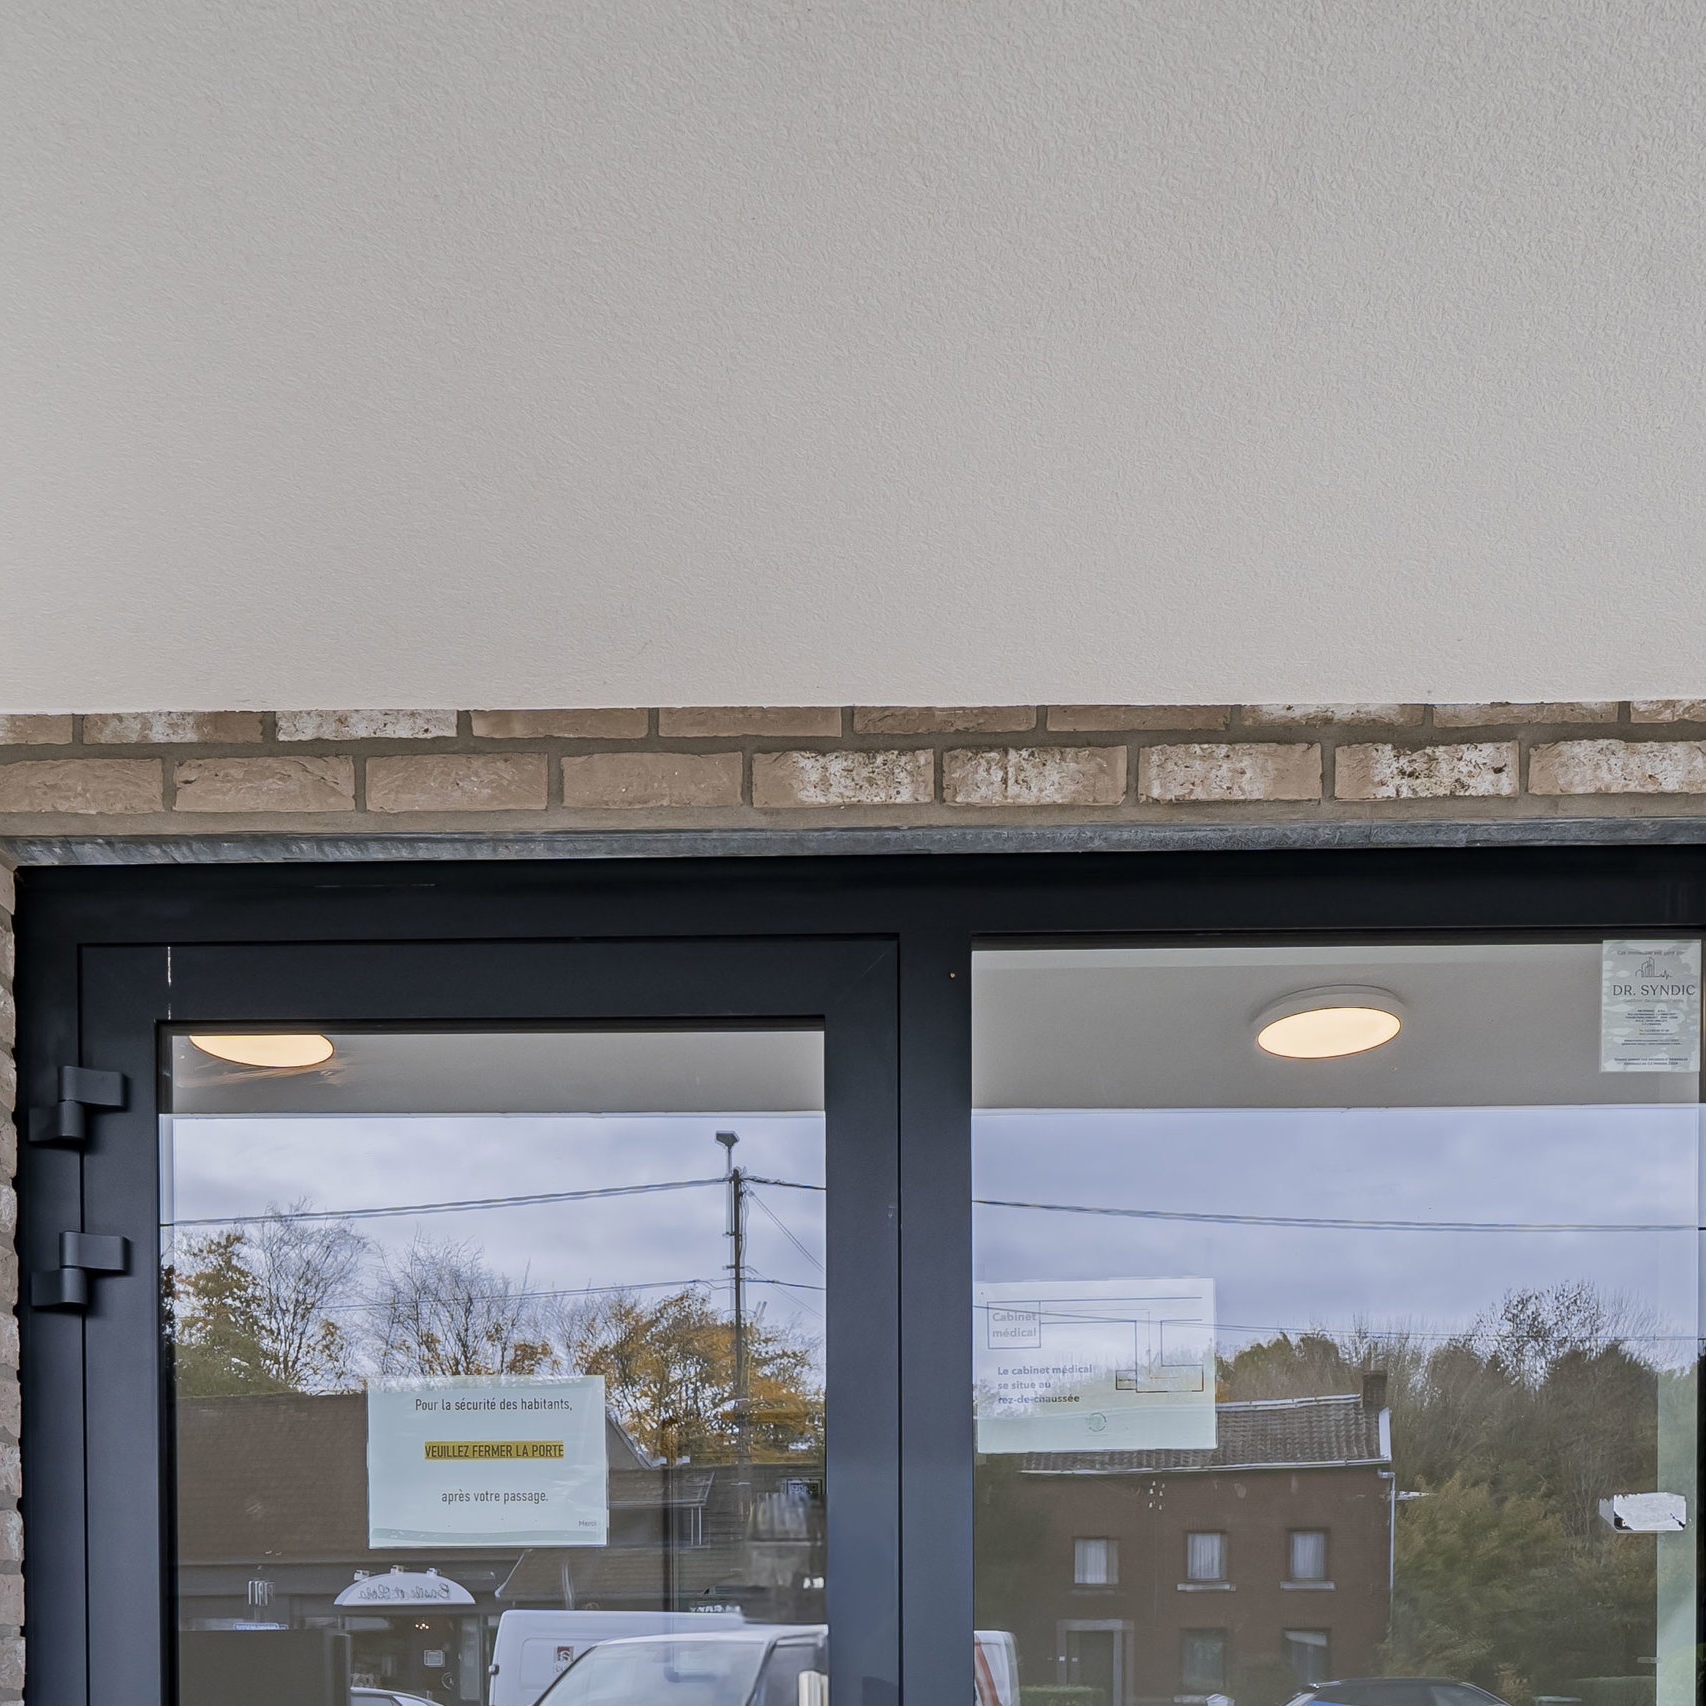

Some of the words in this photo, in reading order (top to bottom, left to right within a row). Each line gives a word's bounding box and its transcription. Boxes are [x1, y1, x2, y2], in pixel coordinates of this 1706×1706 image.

[1613, 984, 1636, 996] DR.
[1640, 984, 1696, 996] SYNDIC
[992, 1312, 1036, 1321] Cabinet
[993, 1327, 1036, 1337] médical
[998, 1366, 1009, 1375] Le
[1012, 1365, 1050, 1375] cabinet
[1052, 1364, 1092, 1374] médical
[1012, 1380, 1036, 1389] situe
[1039, 1381, 1051, 1389] au
[415, 1399, 437, 1411] Pour
[442, 1399, 451, 1410] la
[455, 1397, 496, 1411] sécurité
[500, 1399, 517, 1410] des
[521, 1398, 573, 1411] habitants,
[998, 1394, 1080, 1404] rez-de-chaussée
[425, 1445, 469, 1458] VEUILLEZ
[473, 1444, 512, 1457] FERMER
[516, 1444, 528, 1457] LA
[532, 1444, 564, 1457] PORTE
[442, 1489, 470, 1503] après
[474, 1491, 500, 1502] votre
[504, 1492, 548, 1504] passage.
